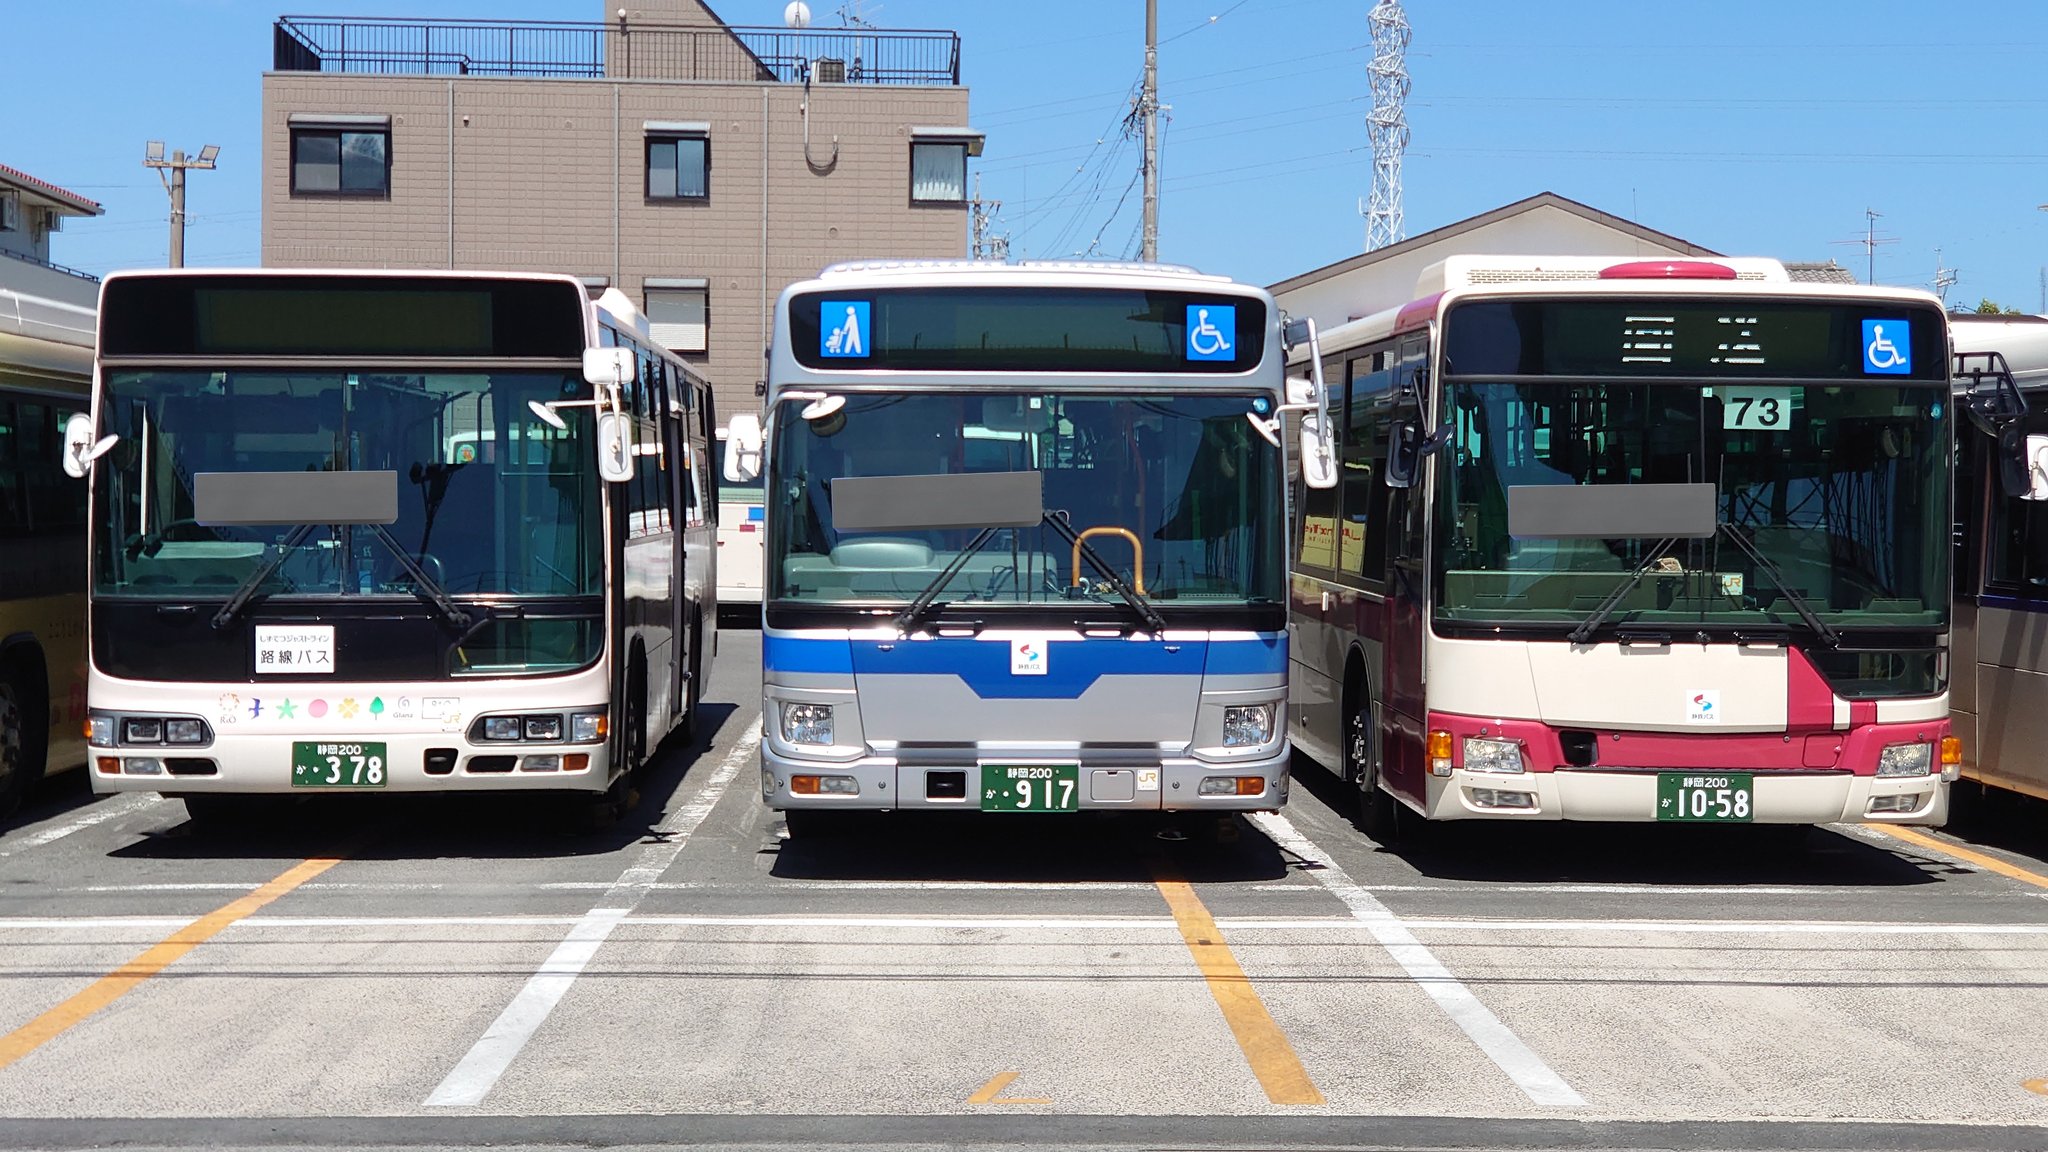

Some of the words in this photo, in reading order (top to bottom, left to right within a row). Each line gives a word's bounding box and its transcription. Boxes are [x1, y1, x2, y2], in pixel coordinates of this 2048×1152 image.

[1731, 397, 1780, 427] 73
[1724, 577, 1741, 588] JR
[260, 649, 330, 664] 路線バス
[296, 764, 307, 775] か
[1139, 772, 1157, 783] JR
[985, 788, 997, 800] か
[1661, 797, 1672, 808] か
[1678, 788, 1749, 818] 10-58
